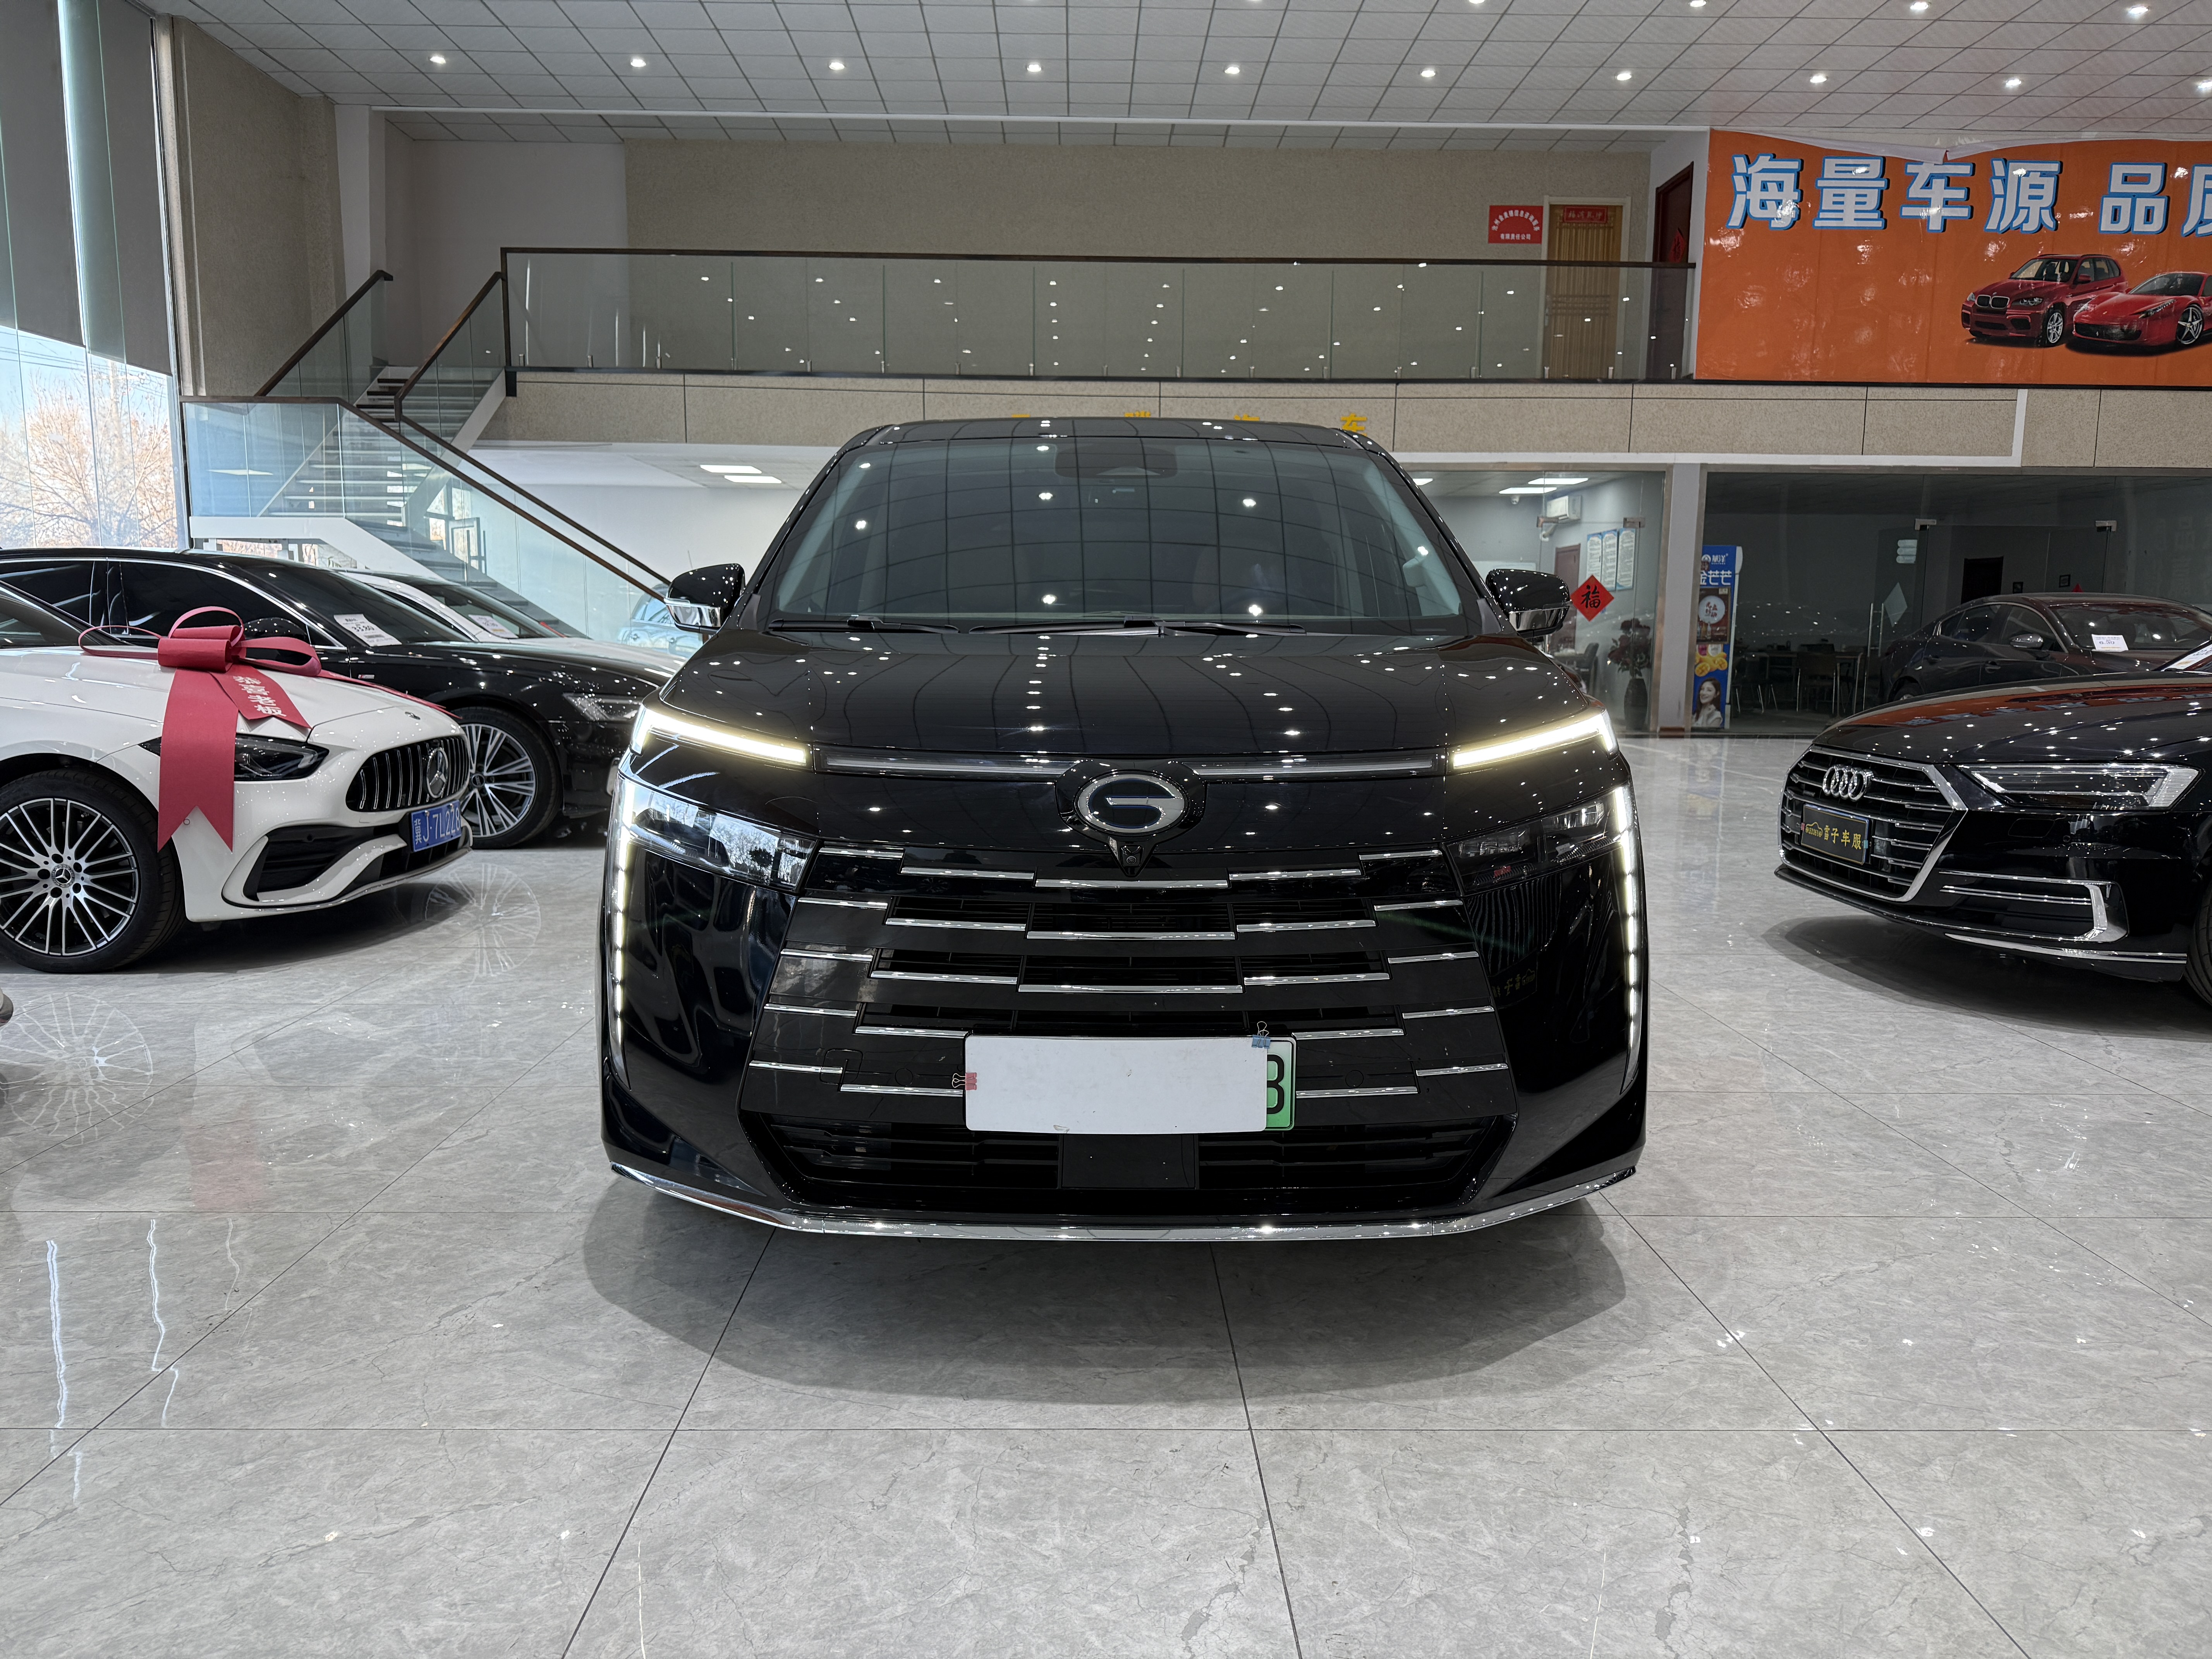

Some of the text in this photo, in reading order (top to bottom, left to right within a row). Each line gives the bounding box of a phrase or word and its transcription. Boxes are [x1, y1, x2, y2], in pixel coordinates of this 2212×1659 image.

[1726, 153, 2064, 234] 海量车源
[1581, 585, 1601, 608] 福
